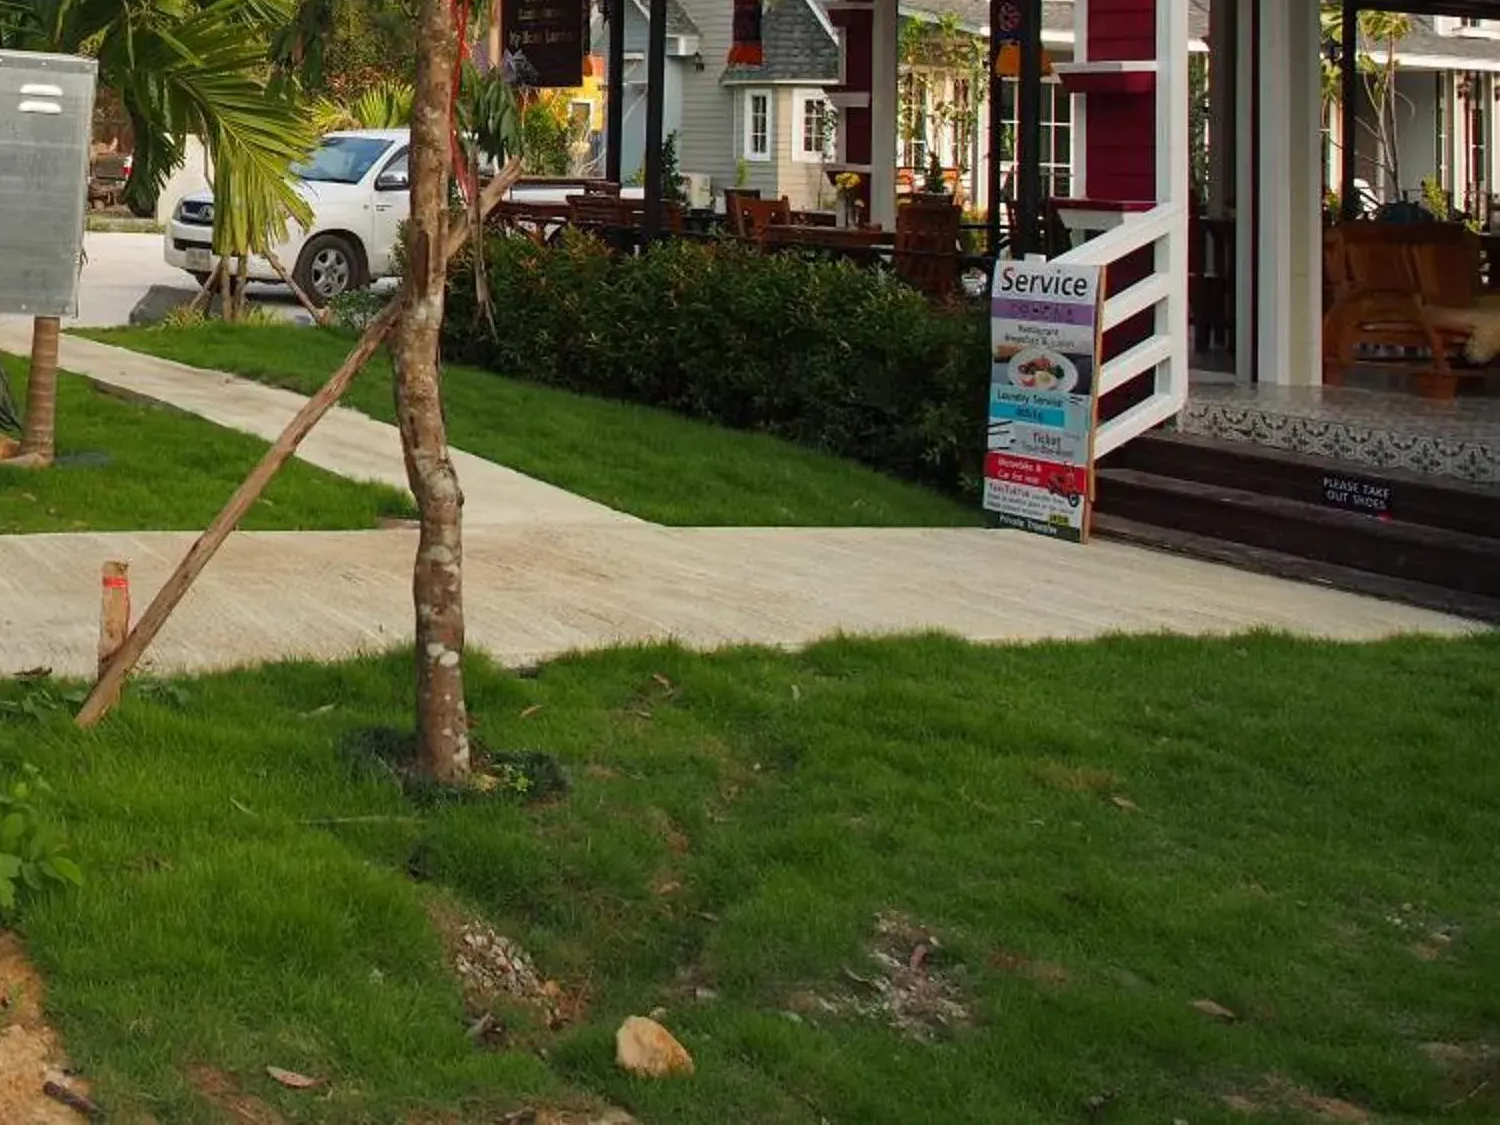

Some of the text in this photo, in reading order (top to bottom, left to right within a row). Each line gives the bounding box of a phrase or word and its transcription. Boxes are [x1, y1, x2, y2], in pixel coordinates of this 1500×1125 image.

[1001, 266, 1088, 297] Service
[1033, 432, 1061, 447] Ticket
[1323, 477, 1390, 499] PLEASE TAKE
[1326, 490, 1387, 510] OUT SHOES
